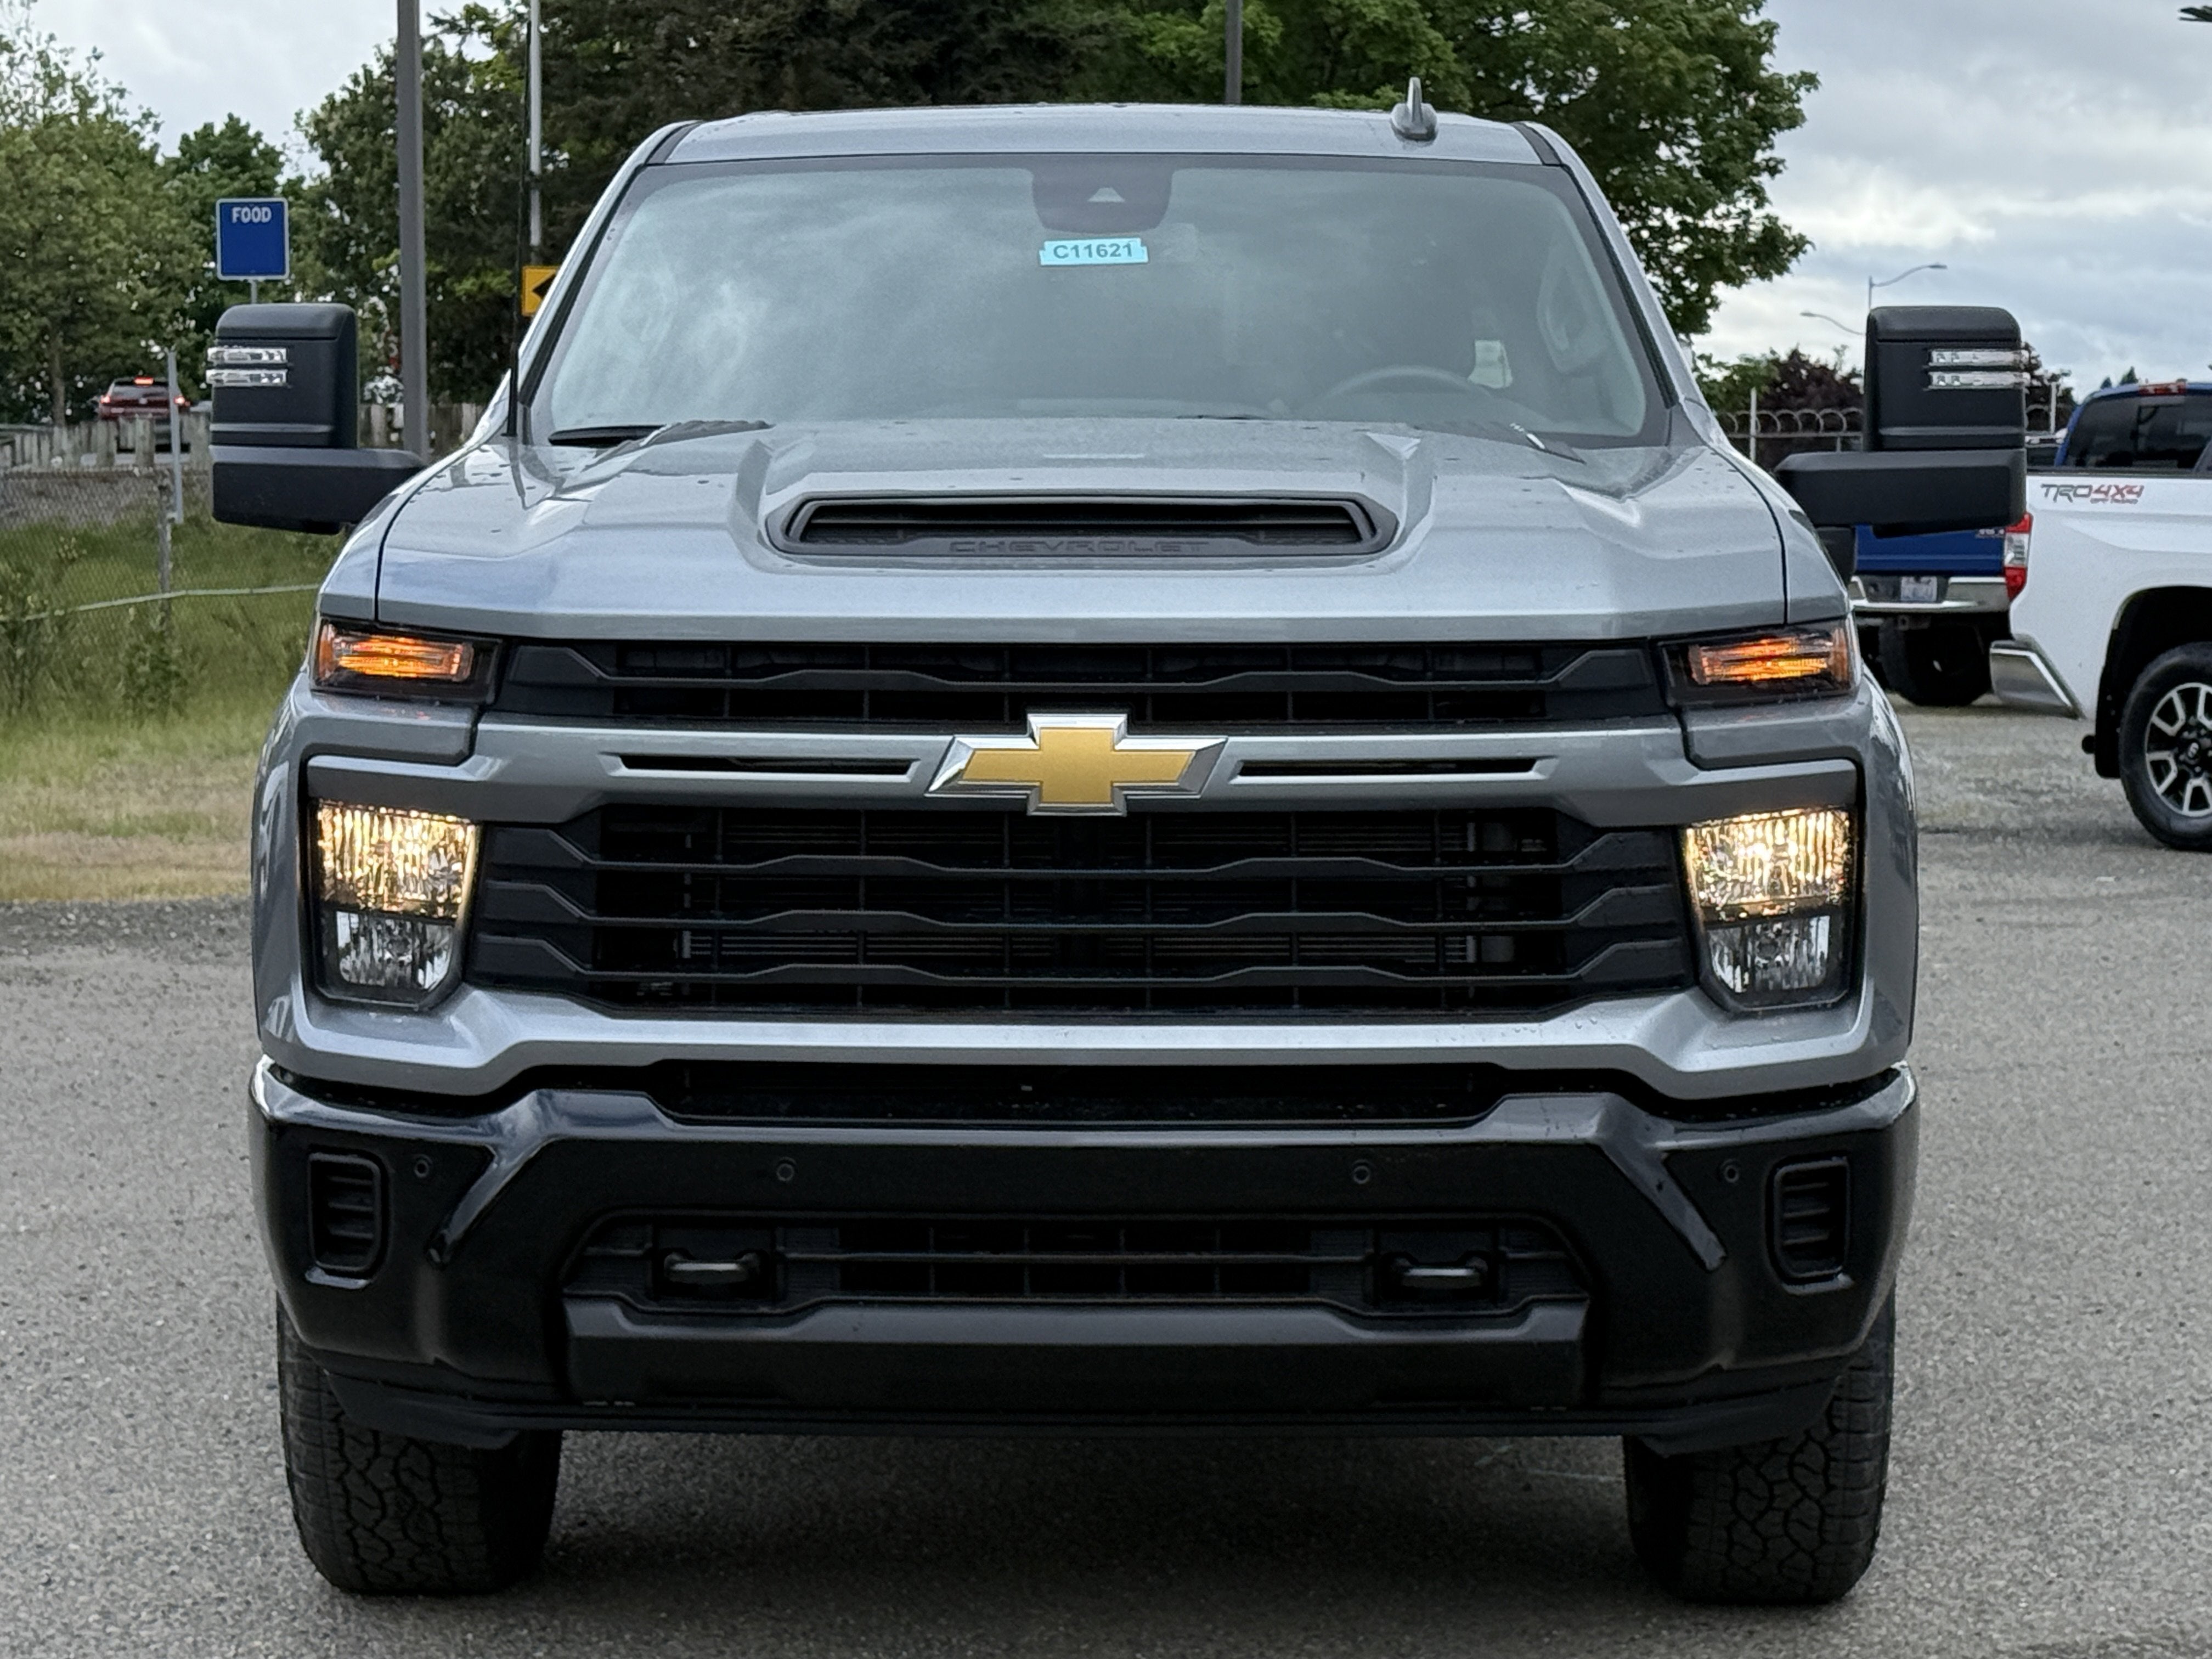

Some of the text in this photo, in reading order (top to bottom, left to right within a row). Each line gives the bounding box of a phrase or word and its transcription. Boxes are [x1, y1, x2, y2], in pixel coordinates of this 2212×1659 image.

[232, 206, 272, 223] FOOD
[1053, 242, 1132, 259] C11621
[950, 540, 1209, 553] CHEVROLET
